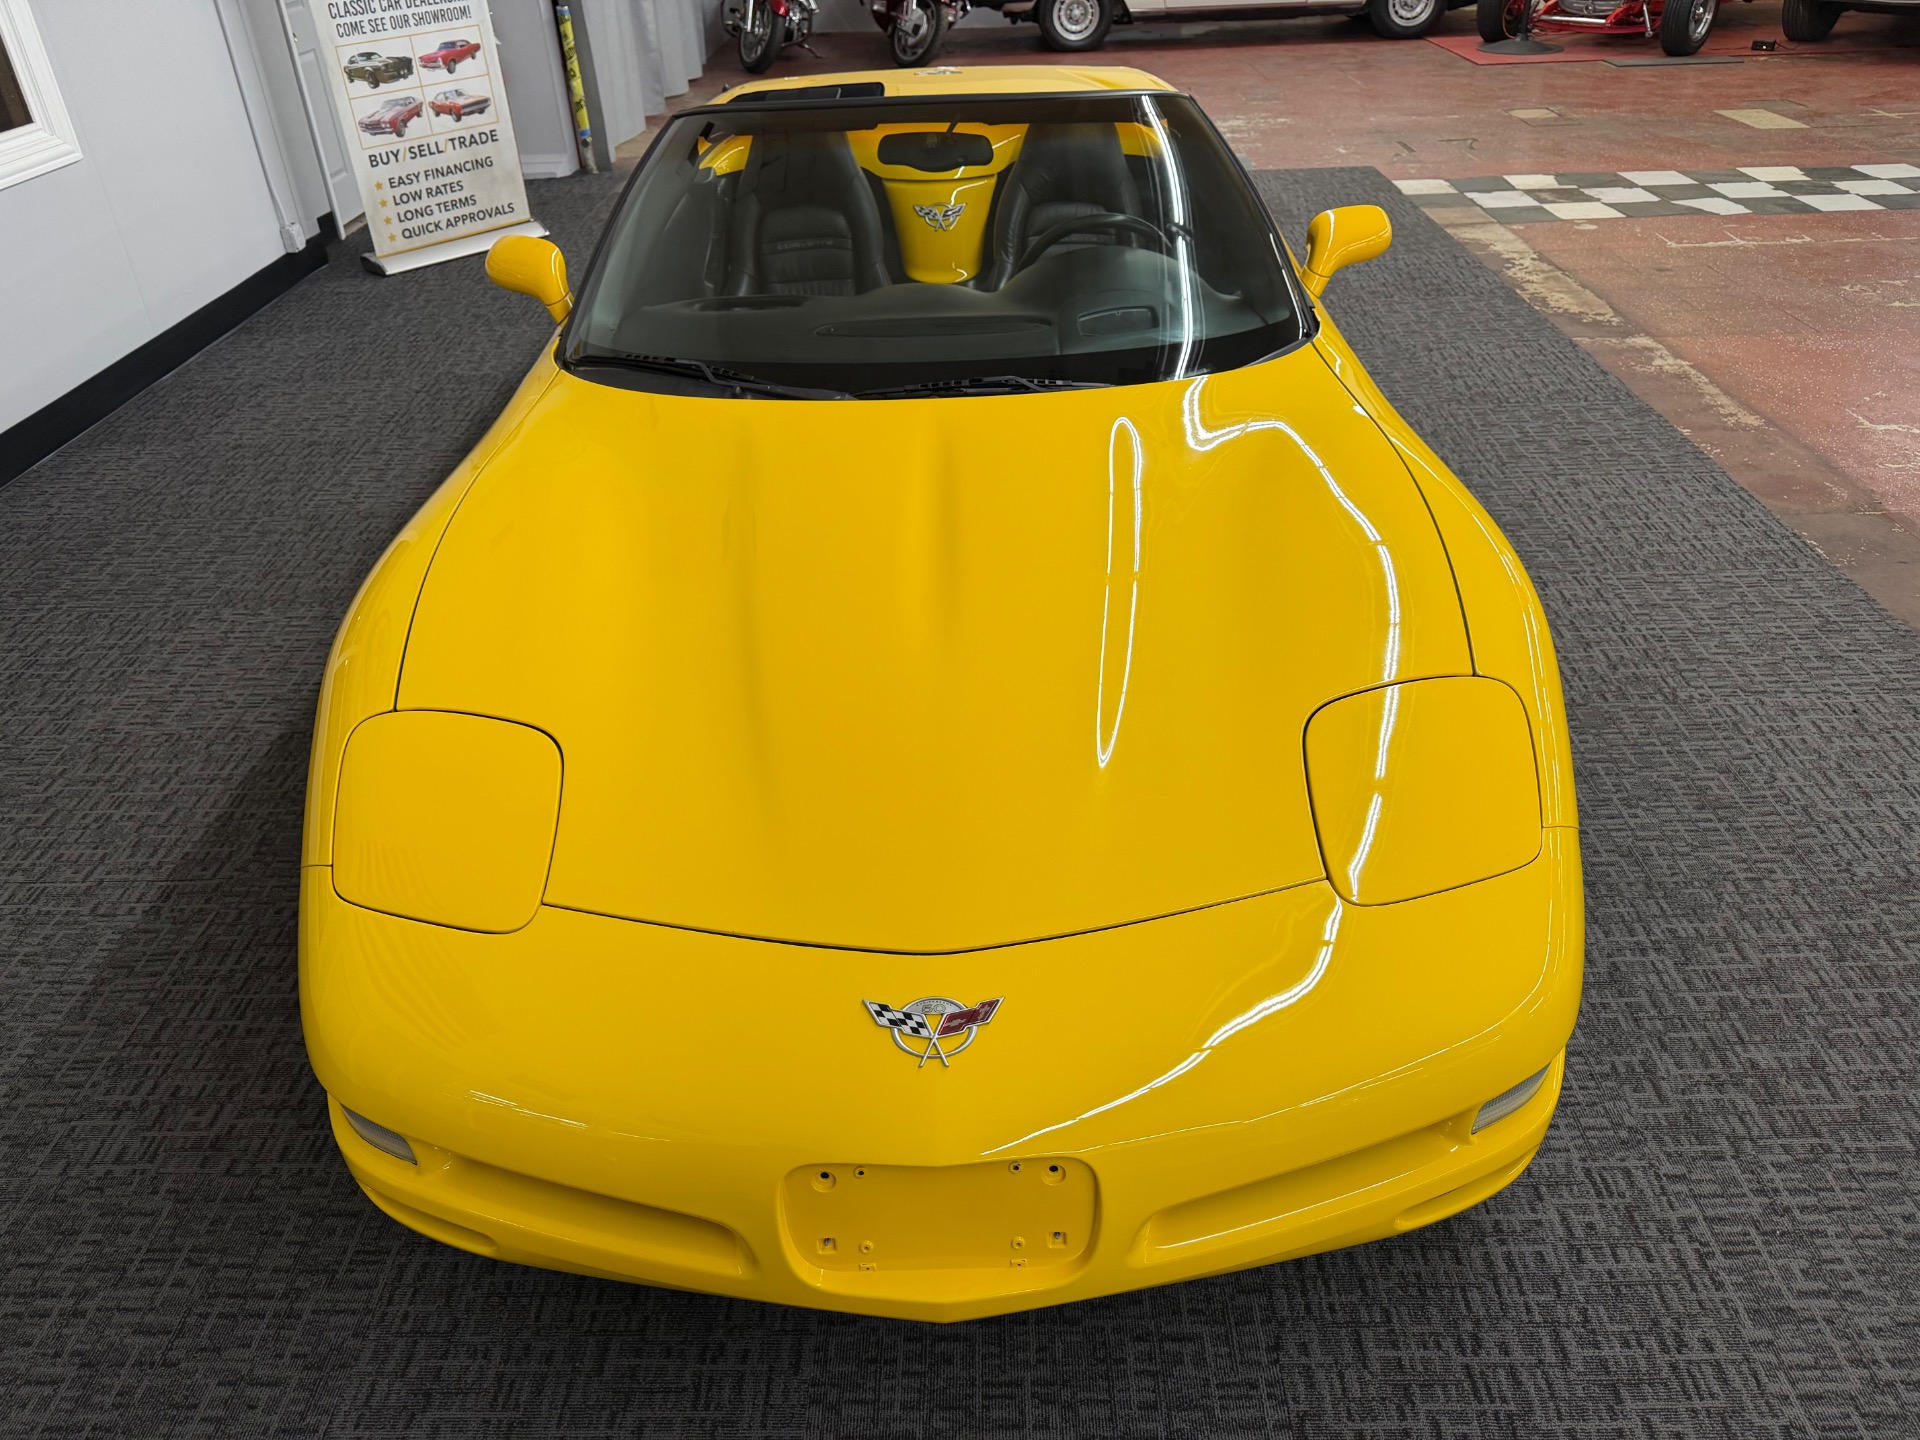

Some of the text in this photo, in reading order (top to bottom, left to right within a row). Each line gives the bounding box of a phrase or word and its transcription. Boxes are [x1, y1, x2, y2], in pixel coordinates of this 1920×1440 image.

[327, 0, 376, 19] CLASSIC
[379, 0, 403, 12] CAR
[336, 5, 472, 38] COME SEE OUR SHOWROOM!
[388, 156, 494, 189] EASY FINANCING
[392, 180, 464, 206] LOW RATES
[397, 194, 477, 223] LONG TERMS
[402, 202, 515, 239] QUICK APPROVALS
[921, 1003, 947, 1013] 50
